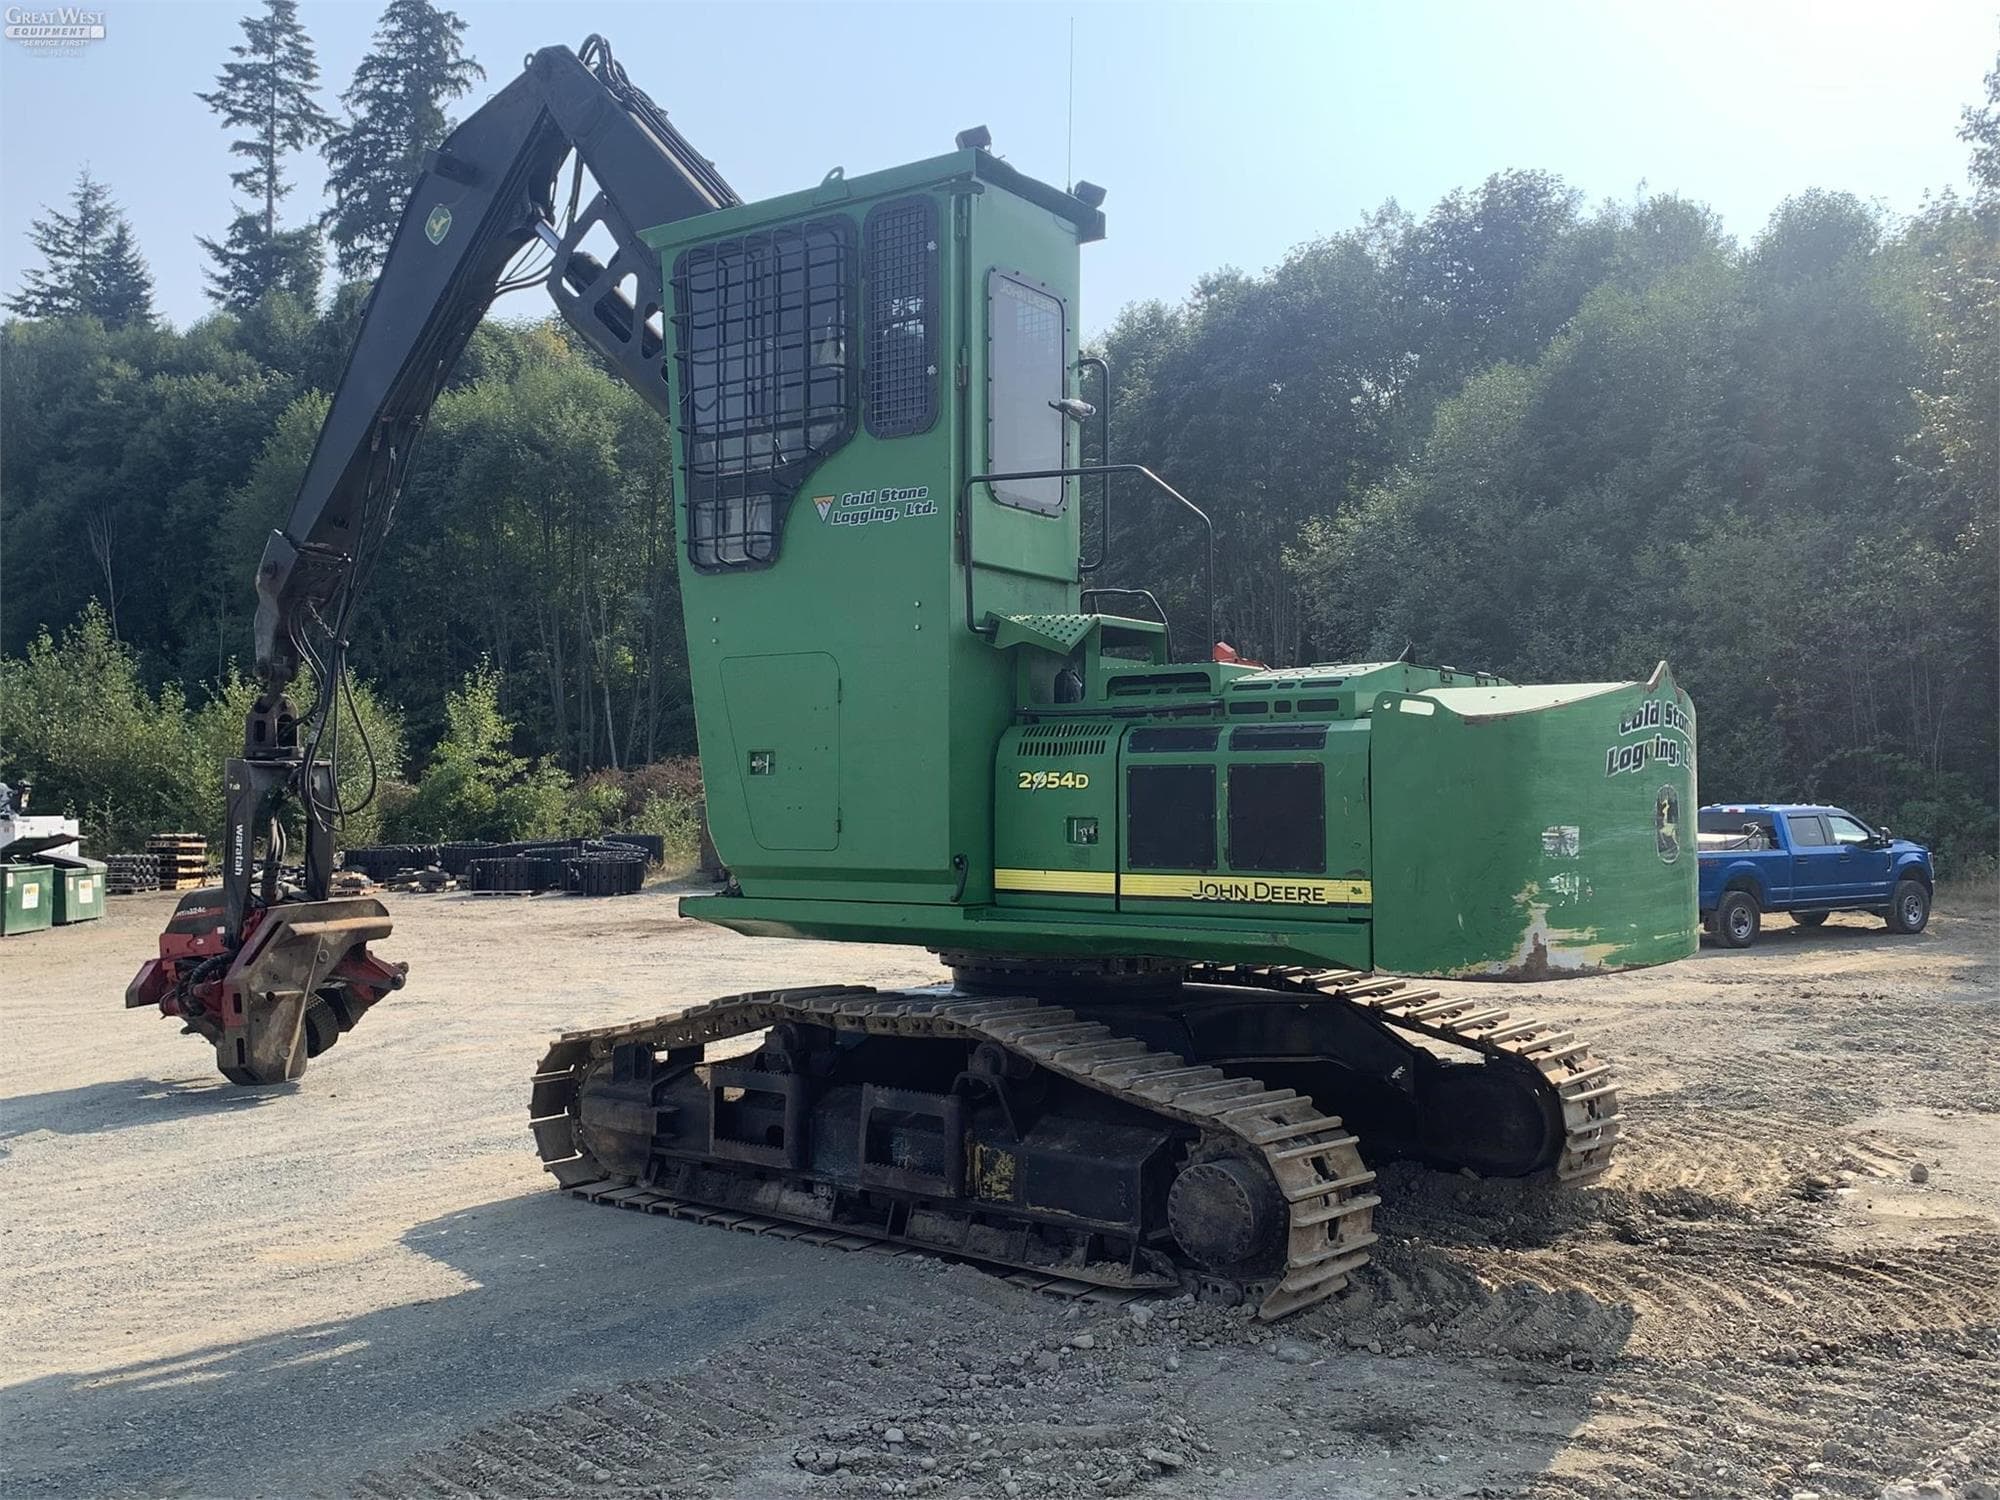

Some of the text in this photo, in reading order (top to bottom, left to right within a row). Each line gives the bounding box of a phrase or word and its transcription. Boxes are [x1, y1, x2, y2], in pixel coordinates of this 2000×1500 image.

[841, 486, 928, 507] Cold Stone
[831, 500, 938, 526] Logging, Ltd.
[1018, 771, 1090, 789] 2954D
[235, 824, 243, 876] waratah
[1192, 880, 1327, 904] JOHN DEERE
